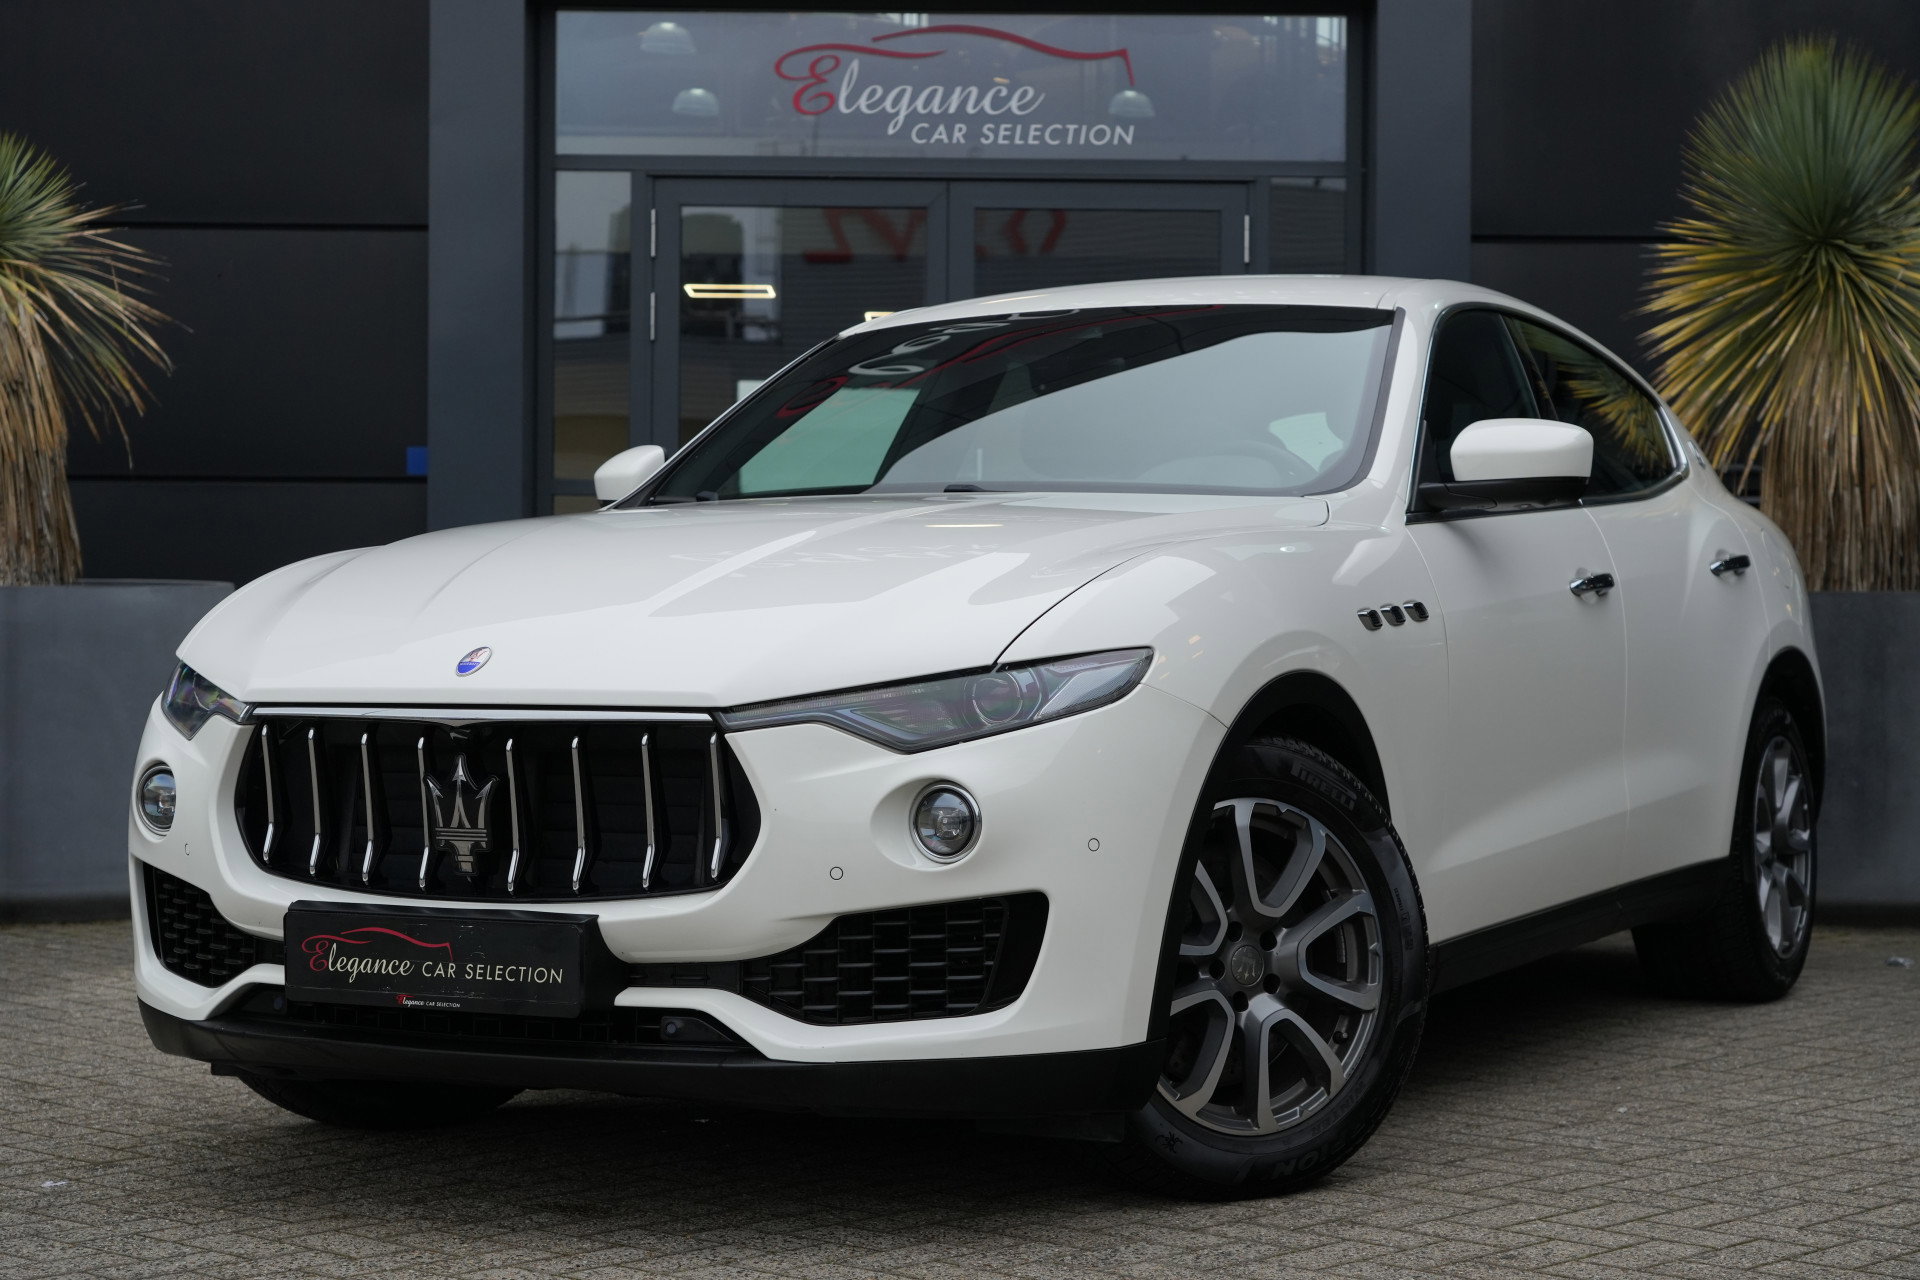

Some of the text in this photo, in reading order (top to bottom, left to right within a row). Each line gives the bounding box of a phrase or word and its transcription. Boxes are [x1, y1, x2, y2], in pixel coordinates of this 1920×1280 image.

[775, 44, 1045, 135] Elegance
[910, 123, 1135, 146] CAR SELECTION
[302, 935, 564, 985] Elegance CAR SELECTION
